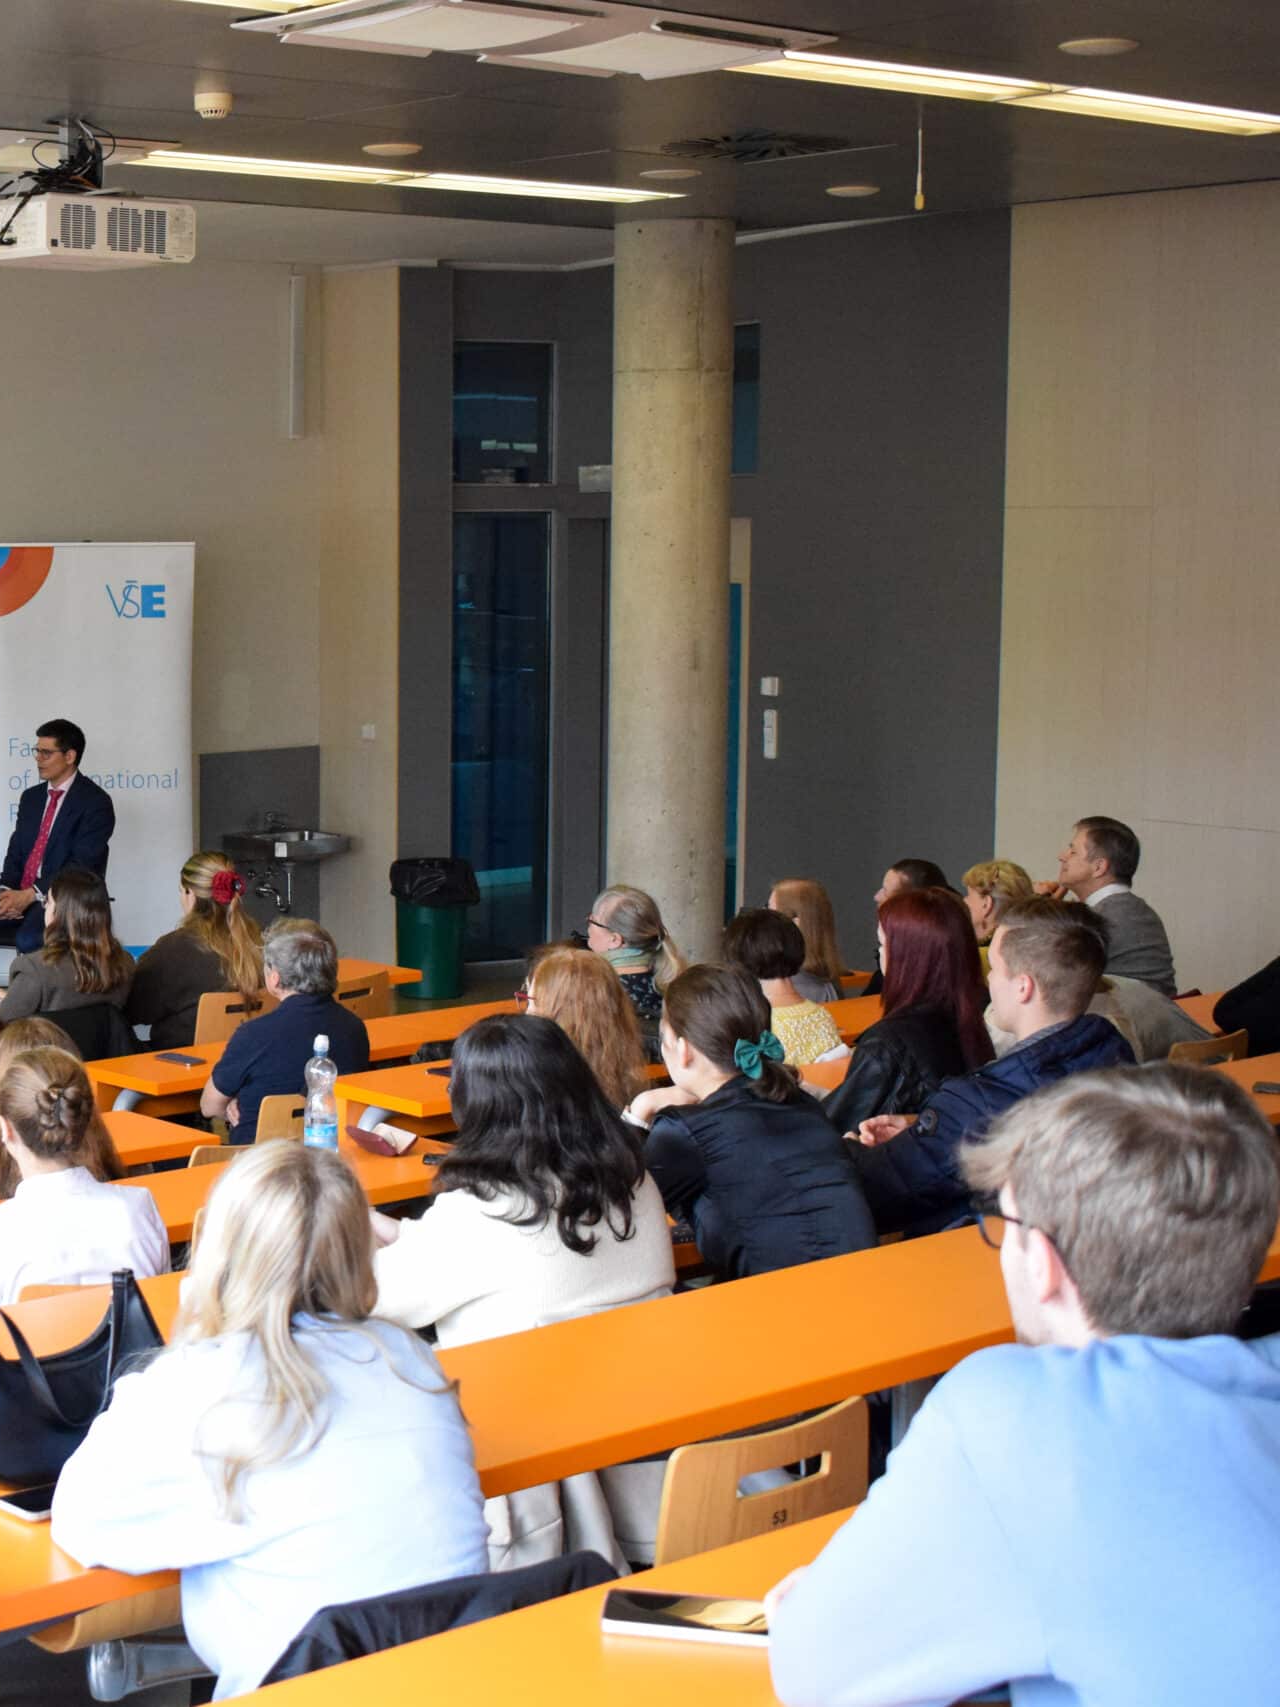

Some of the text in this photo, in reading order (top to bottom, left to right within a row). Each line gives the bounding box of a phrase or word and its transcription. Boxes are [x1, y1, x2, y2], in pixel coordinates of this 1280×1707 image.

[106, 580, 167, 619] VŠE
[8, 768, 31, 791] of
[772, 1509, 788, 1525] 53
